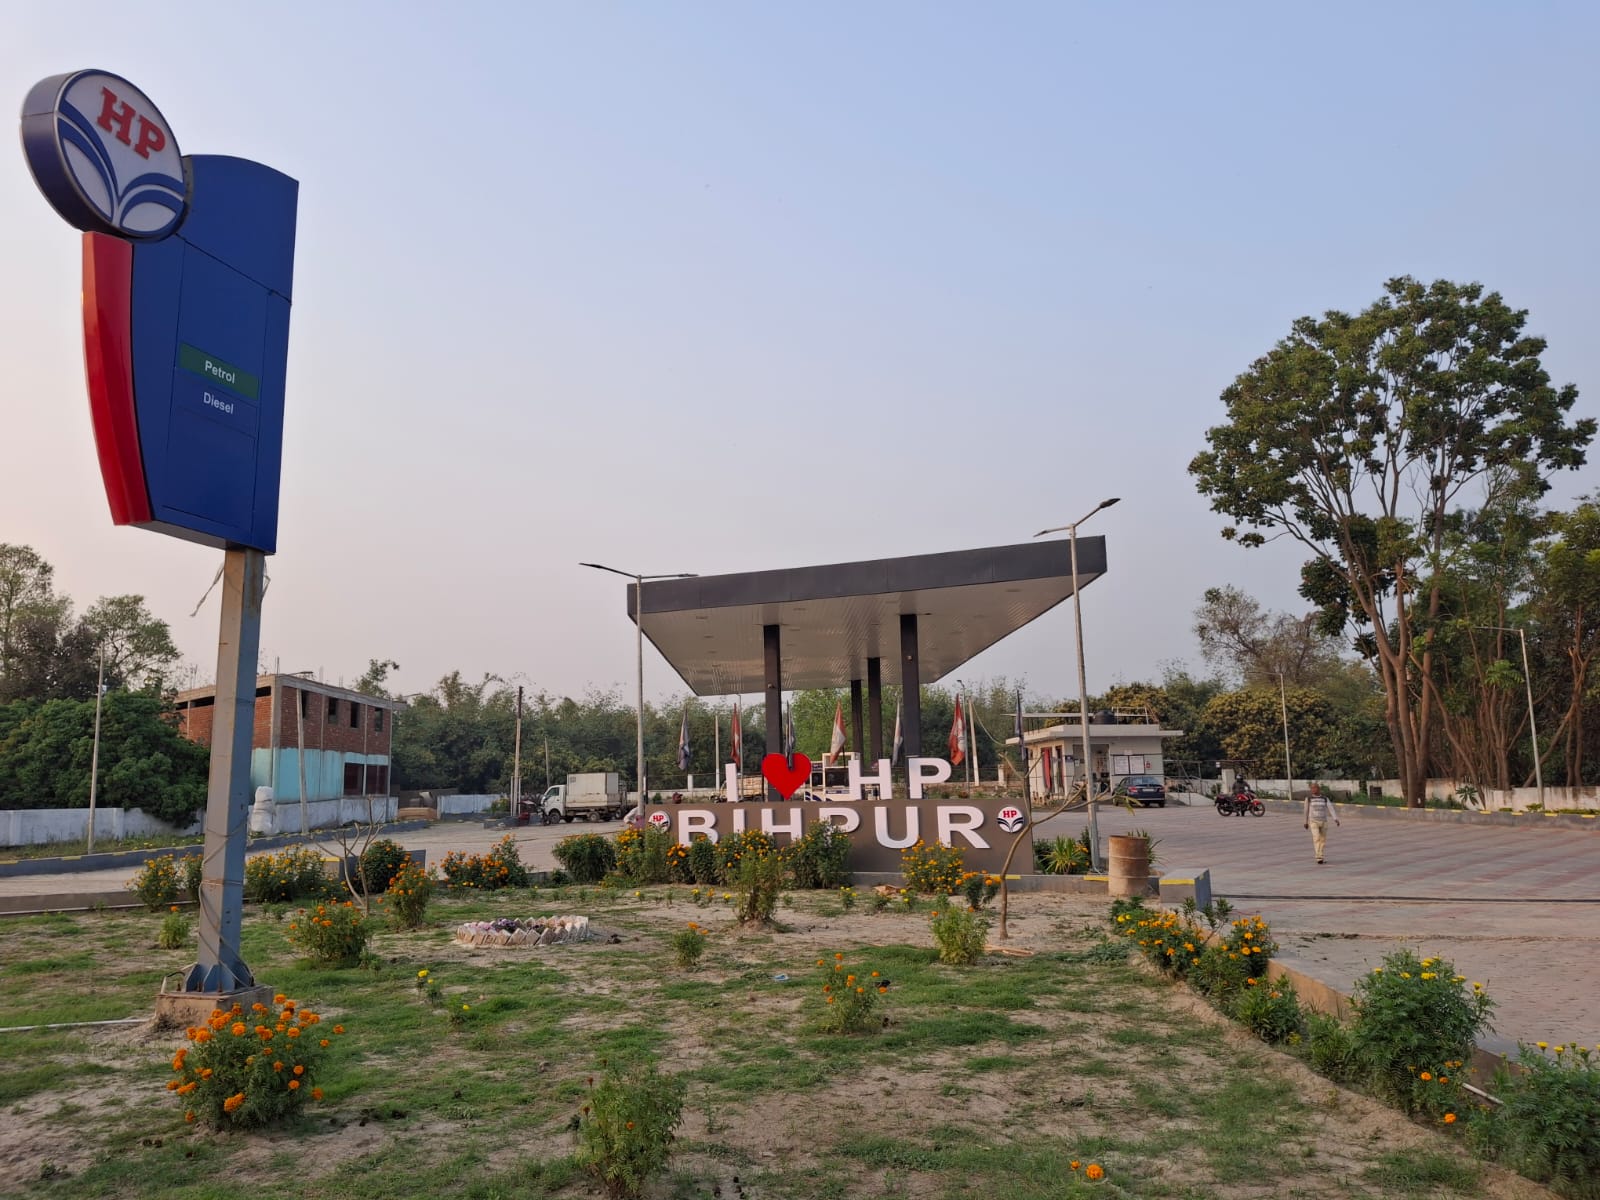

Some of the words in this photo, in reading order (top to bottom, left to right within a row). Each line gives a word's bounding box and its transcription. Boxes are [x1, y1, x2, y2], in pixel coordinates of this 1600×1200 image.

[97, 87, 166, 160] HP
[205, 360, 236, 384] Petrol
[203, 392, 234, 414] Diesel
[725, 763, 739, 802] I
[848, 757, 952, 800] HP
[678, 806, 990, 849] BIHPUR
[1002, 810, 1018, 818] HP
